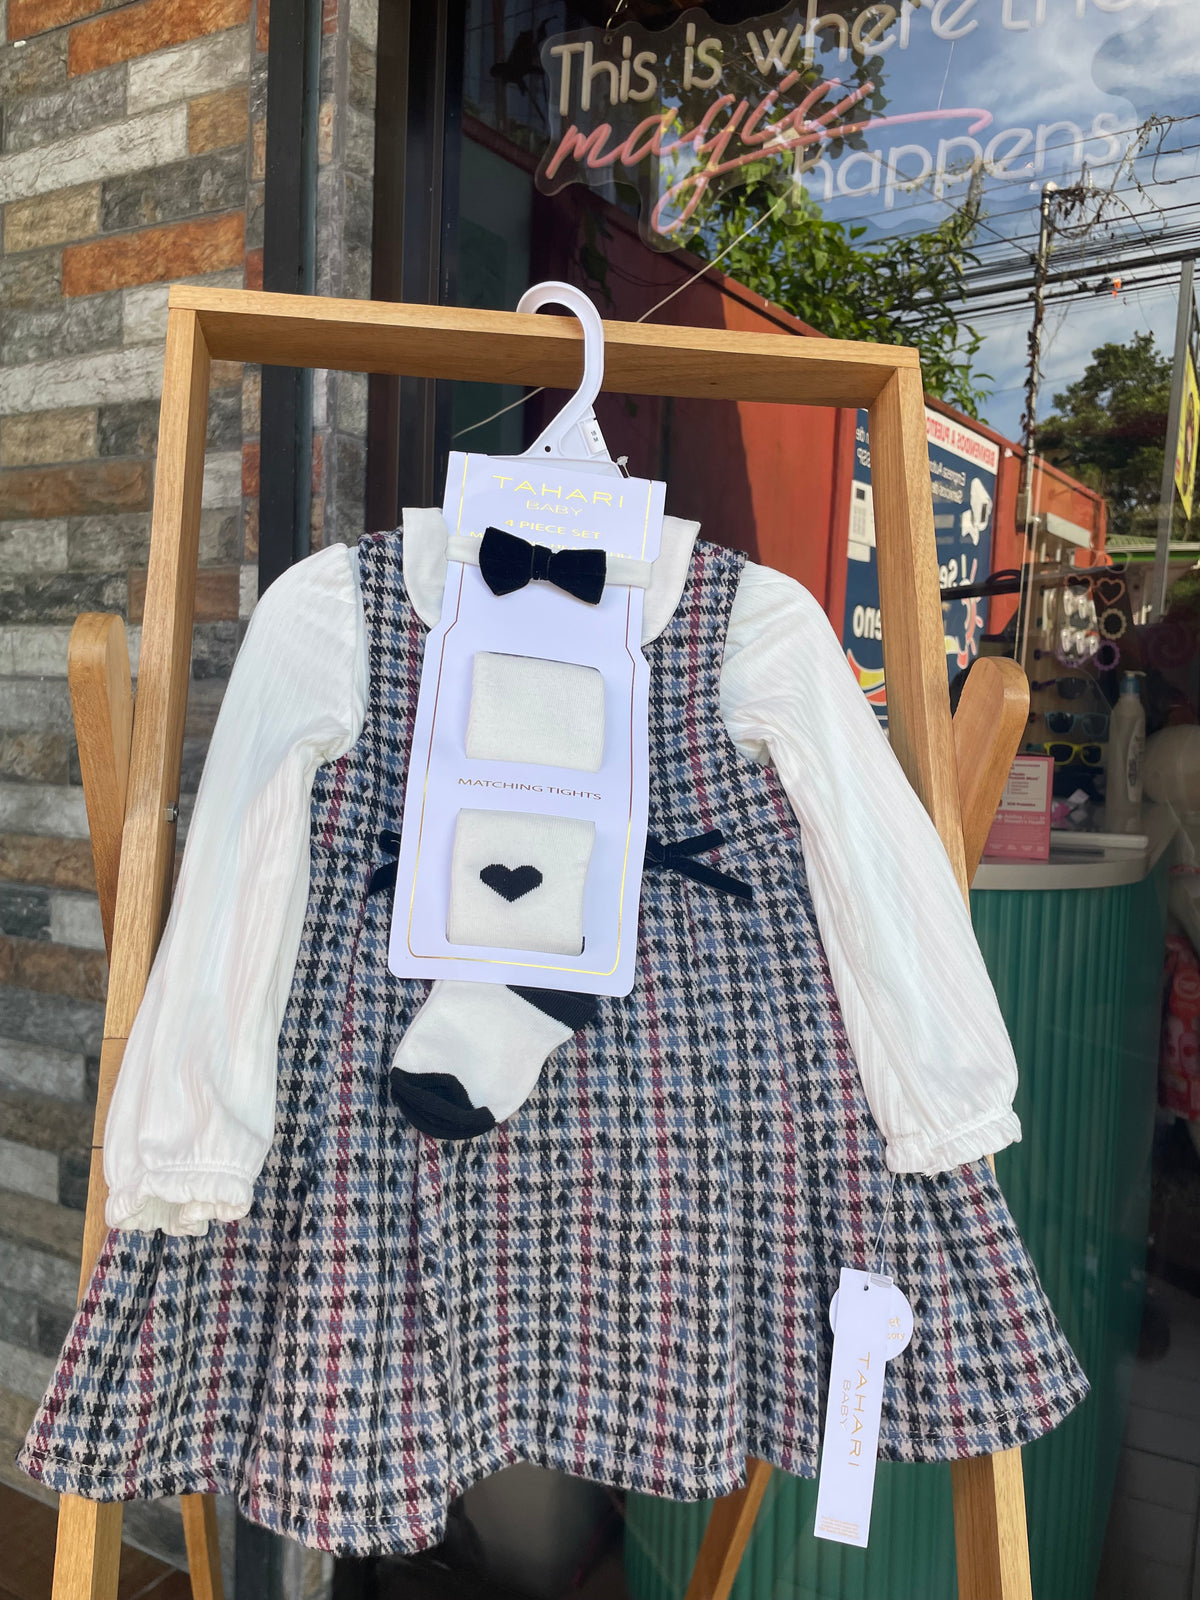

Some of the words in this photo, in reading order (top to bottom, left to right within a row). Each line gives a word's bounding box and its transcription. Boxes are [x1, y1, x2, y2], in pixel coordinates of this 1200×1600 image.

[551, 36, 658, 116] This
[684, 23, 722, 90] is
[746, 0, 978, 75] where
[546, 71, 993, 234] magic
[793, 112, 1121, 209] happens
[492, 474, 624, 508] TAHARI
[526, 500, 583, 516] BABY
[504, 519, 514, 527] 4
[519, 520, 566, 535] PIECE
[571, 530, 601, 540] SET
[458, 778, 543, 792] MATCHING
[547, 786, 602, 800] TIGHTS
[839, 1379, 851, 1432] BABY
[848, 1352, 870, 1467] TAHARI
